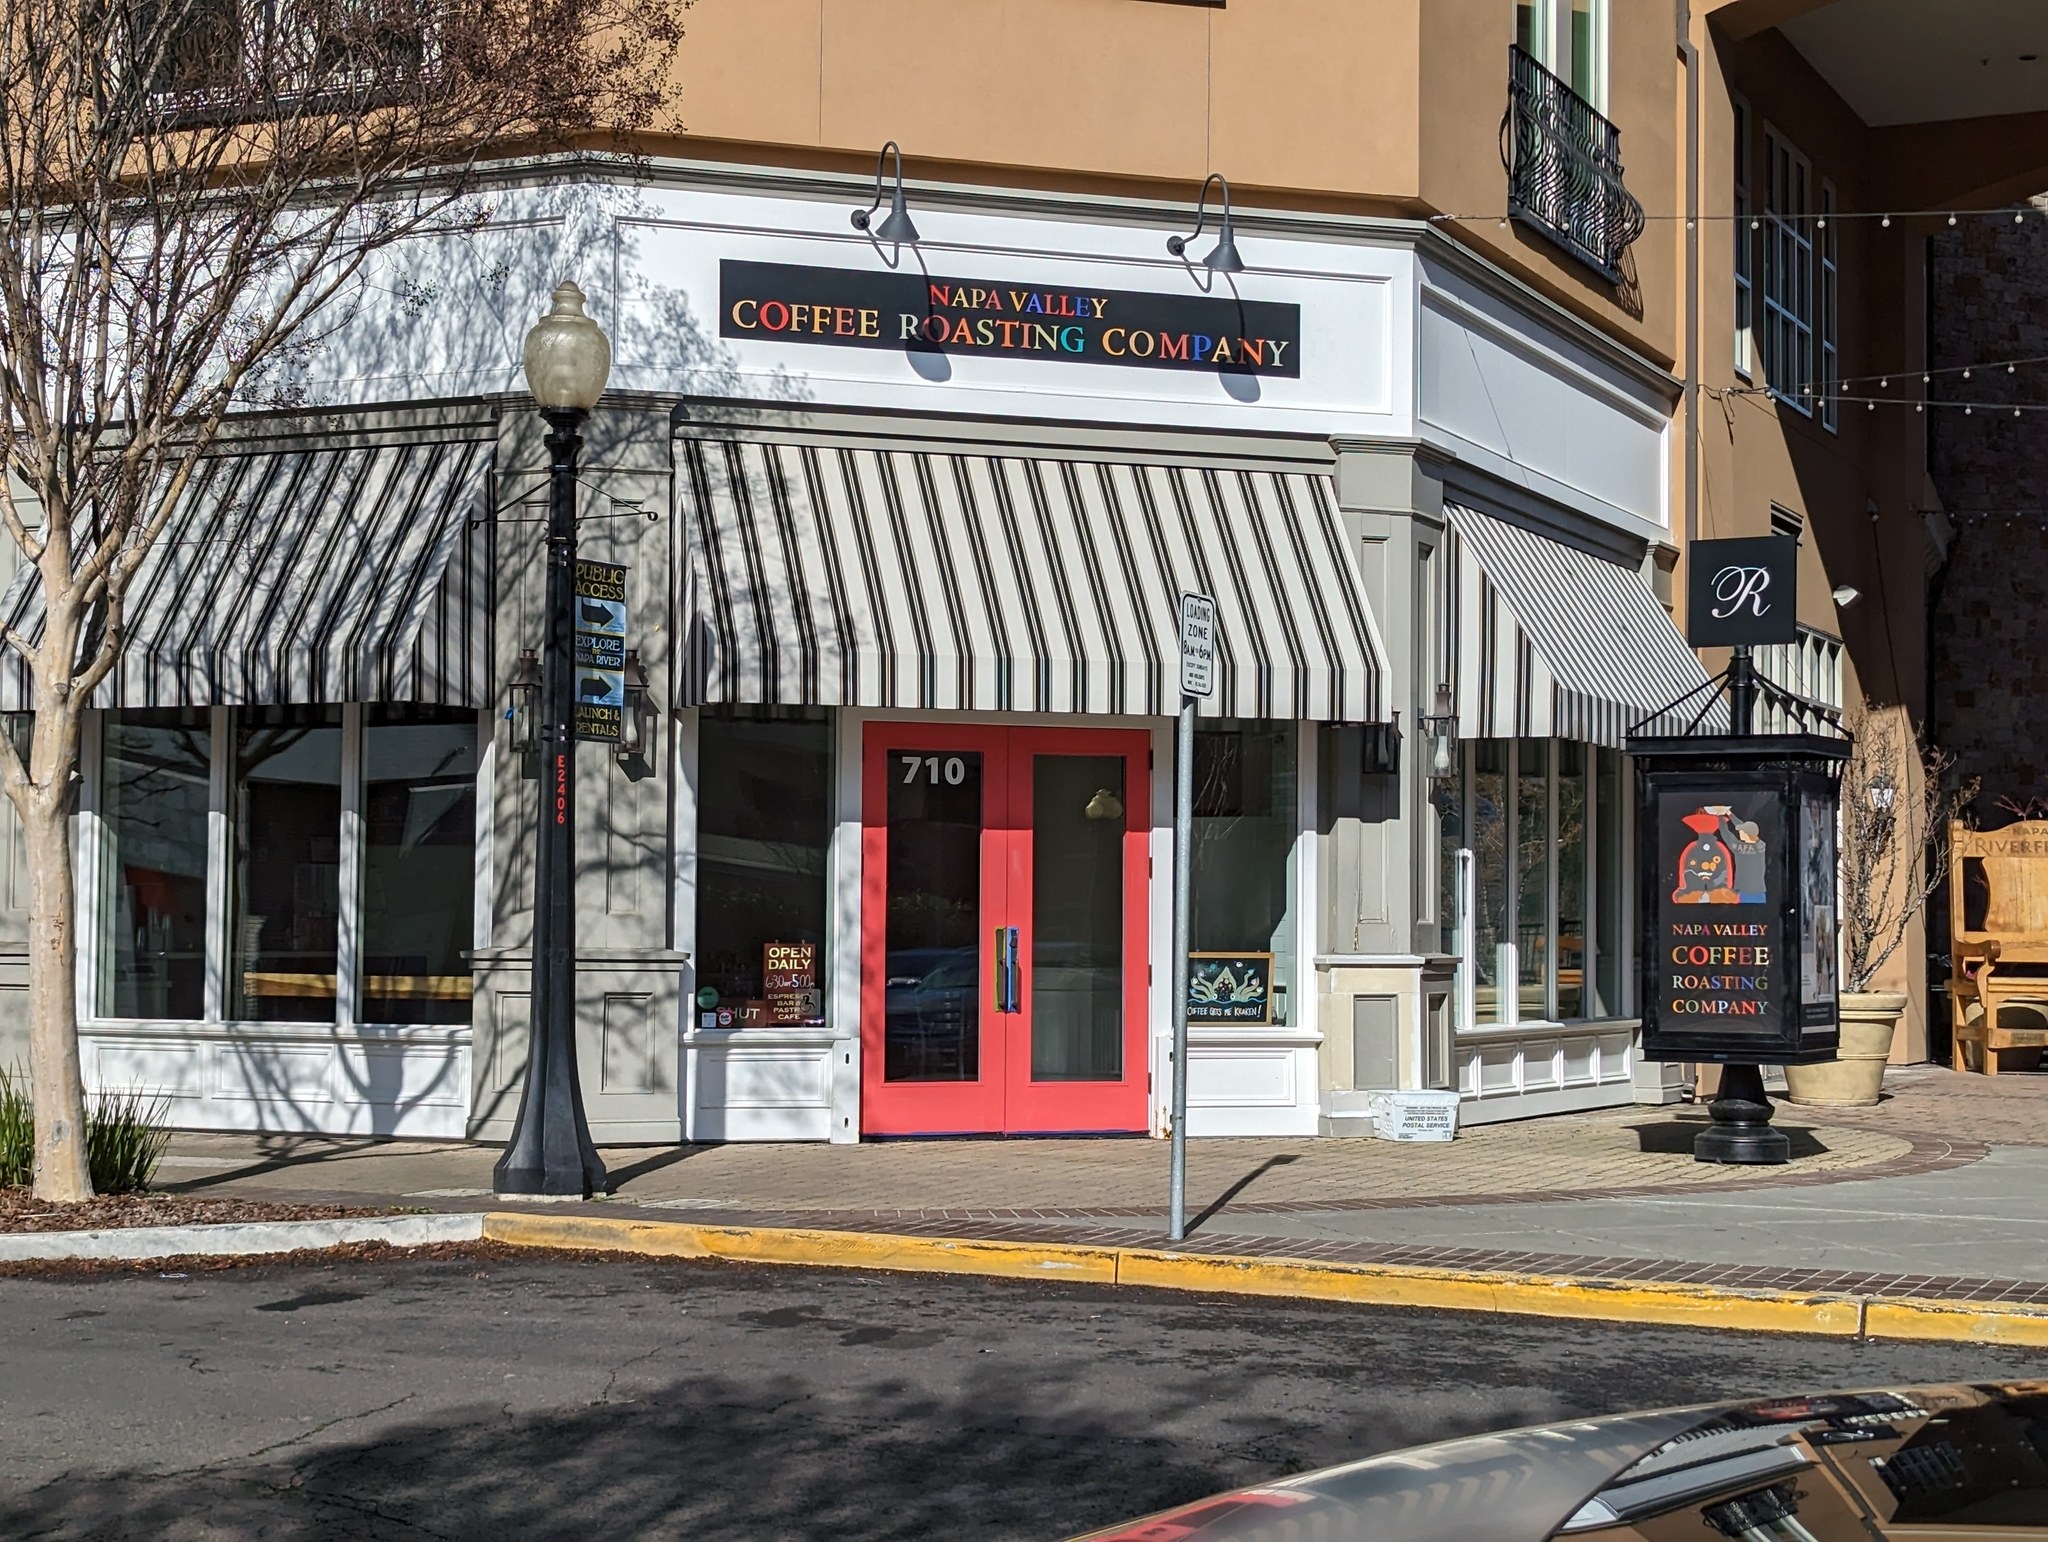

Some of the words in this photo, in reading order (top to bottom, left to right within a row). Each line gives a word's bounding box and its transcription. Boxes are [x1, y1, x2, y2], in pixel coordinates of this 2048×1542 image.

[929, 284, 1003, 312] NAPA
[1008, 291, 1109, 319] VALLEY
[731, 299, 881, 338] COFFEE
[899, 313, 1086, 353] ROASTING
[1102, 327, 1289, 367] COMPANY
[575, 563, 625, 585] PUBLIC
[575, 580, 624, 600] ACCESS
[1186, 602, 1211, 622] LOADING
[1187, 623, 1208, 640] ZONE
[575, 635, 621, 651] EXPLORE
[575, 652, 595, 664] NAPA
[596, 655, 621, 667] RIVER
[575, 705, 613, 720] LAUNCH
[613, 709, 620, 721] &
[575, 721, 619, 737] RENTALS
[901, 756, 965, 785] 710
[1672, 924, 1711, 936] NAPA
[1713, 924, 1768, 936] VALLEY
[768, 947, 812, 958] OPEN
[1671, 945, 1770, 966] COFFEE
[768, 959, 812, 970] DAILY
[1672, 974, 1769, 991] ROASTING
[1672, 999, 1769, 1015] COMPANY
